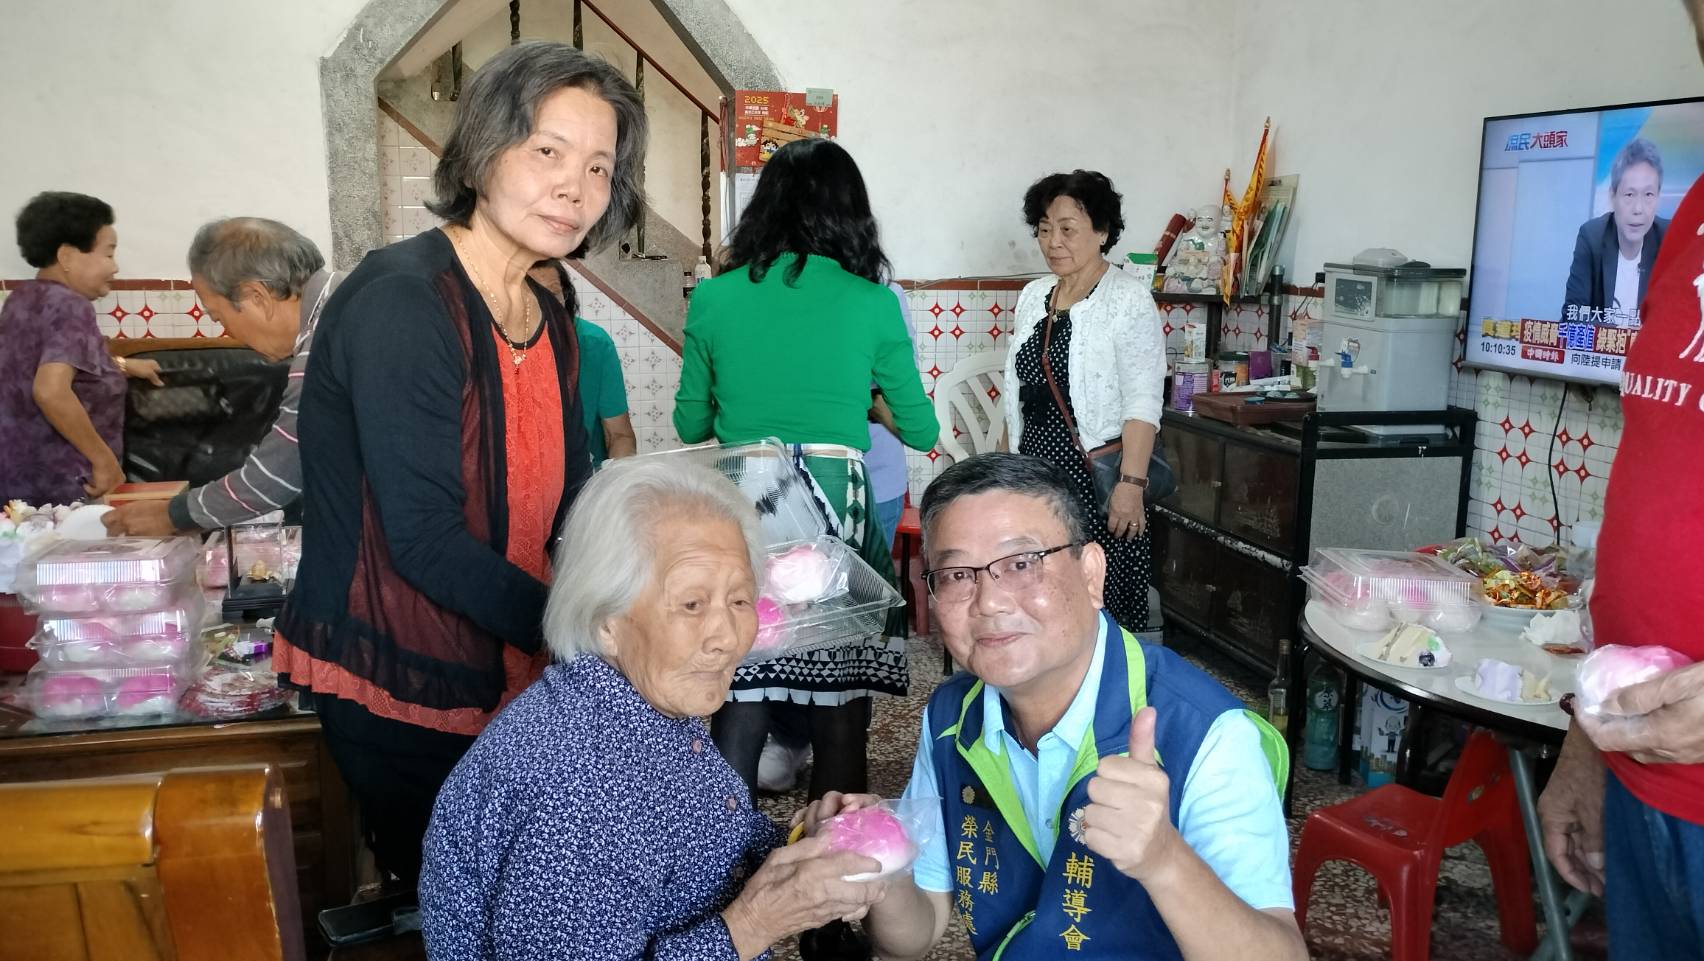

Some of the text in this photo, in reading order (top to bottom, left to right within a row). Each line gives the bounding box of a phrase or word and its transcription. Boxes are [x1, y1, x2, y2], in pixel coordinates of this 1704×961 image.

[744, 95, 769, 104] 2025
[1504, 130, 1569, 152] 庶民大頭家
[1480, 341, 1516, 356] 10:10:35
[1571, 353, 1621, 371] 向陸提申請
[978, 820, 999, 896] 金門縣
[1059, 852, 1095, 951] 輔導會
